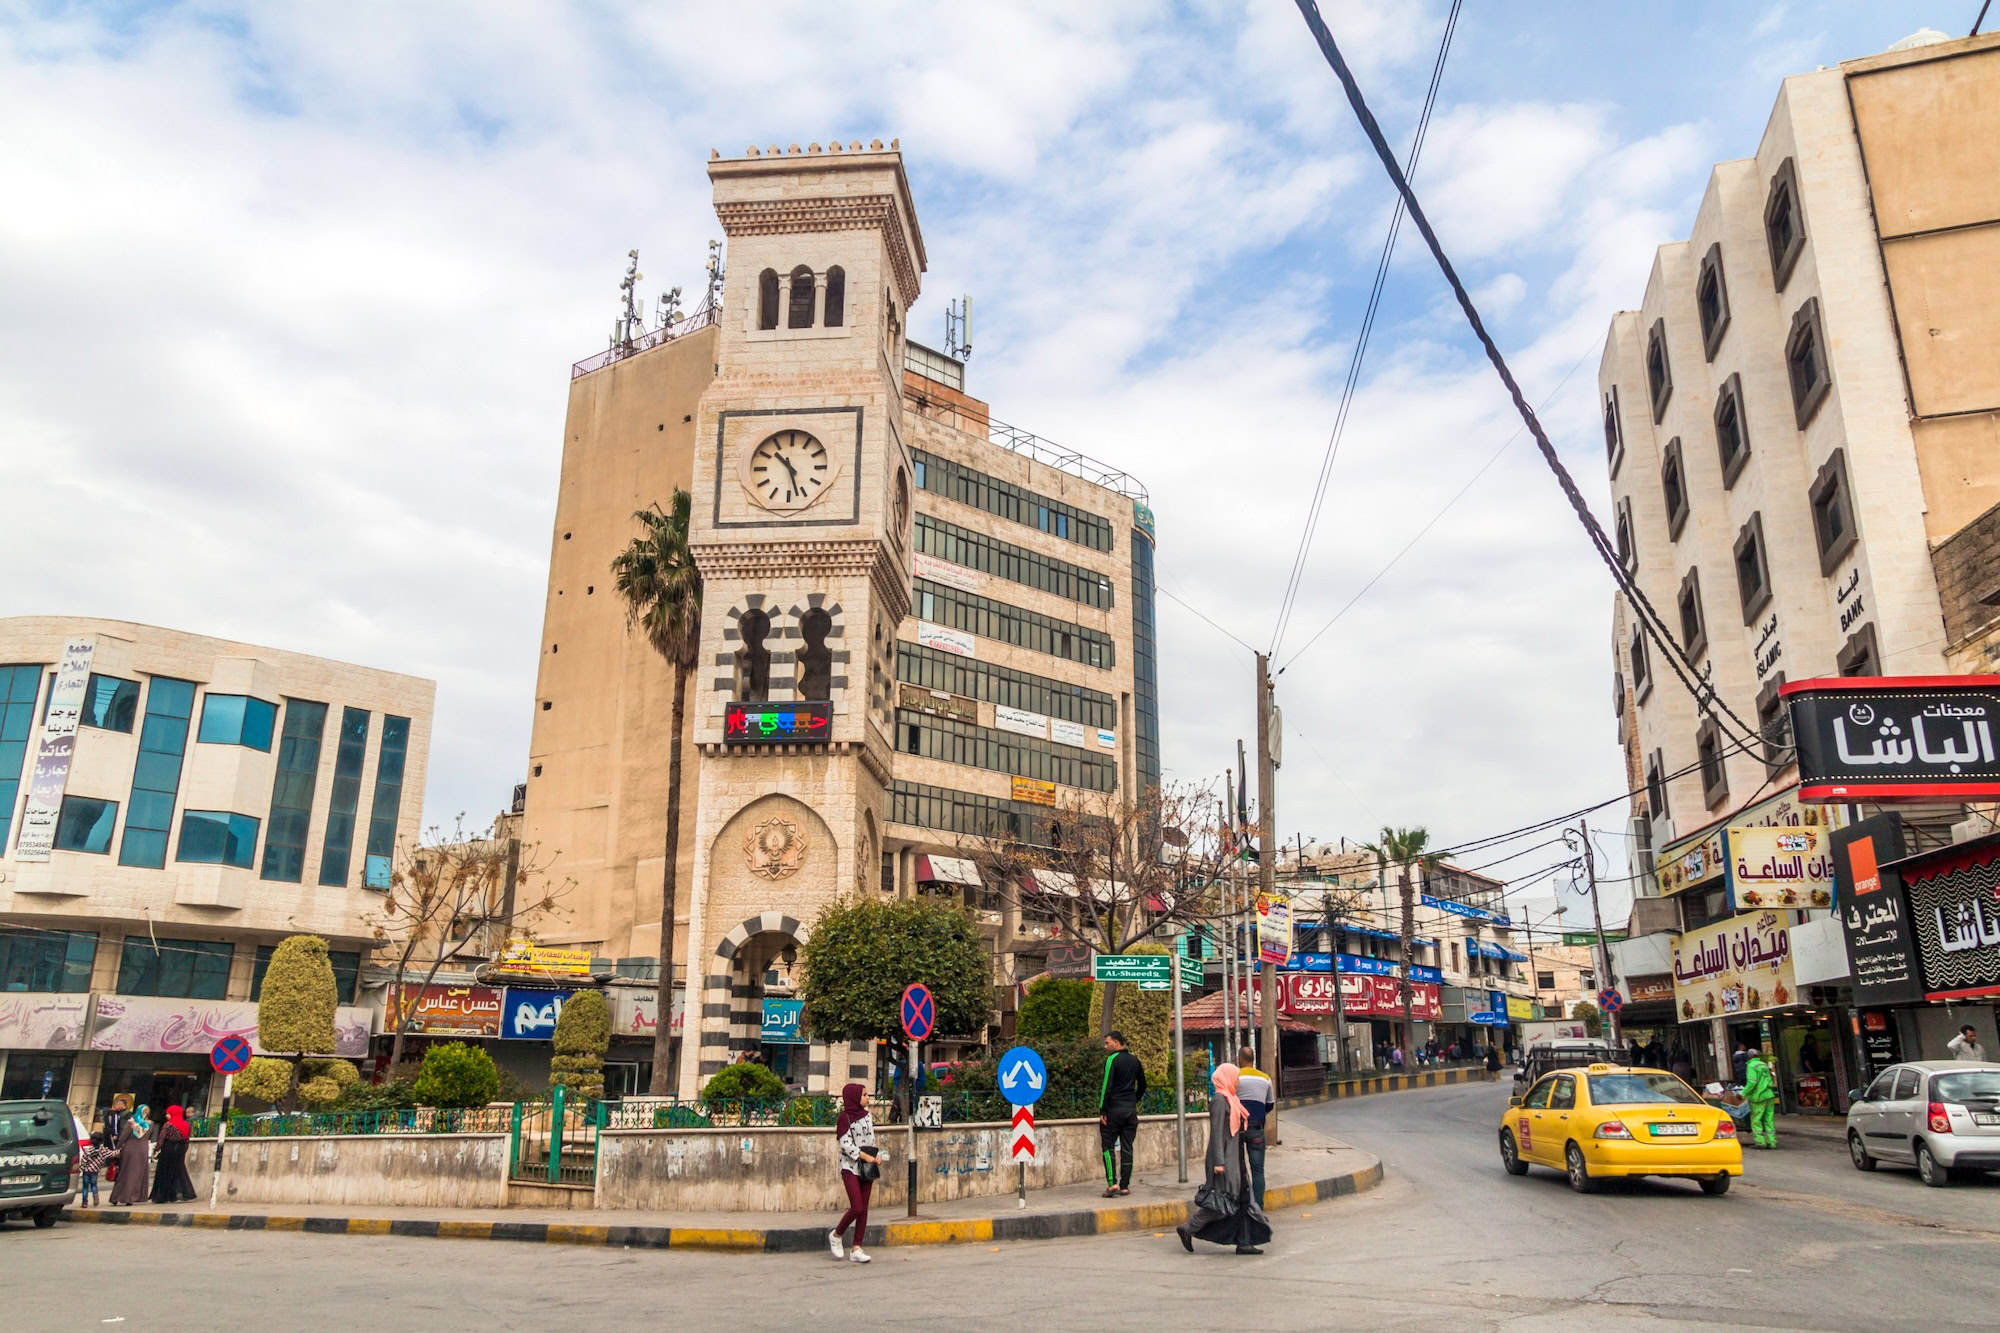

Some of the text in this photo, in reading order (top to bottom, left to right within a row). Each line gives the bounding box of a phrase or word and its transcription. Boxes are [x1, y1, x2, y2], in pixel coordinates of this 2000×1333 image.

[1756, 640, 1782, 681] ISLAMIC
[1839, 594, 1865, 633] BANK
[66, 644, 93, 658] مجمع
[1922, 703, 1986, 720] معجنات
[47, 723, 75, 736] لدينا
[39, 744, 72, 760] مكاتب
[1832, 714, 1996, 774] الباشا
[35, 764, 68, 778] تجارية
[1738, 855, 1805, 880] الساعة
[1854, 876, 1878, 892] orange
[1846, 897, 1900, 934] المحترف
[1674, 926, 1790, 982] ميدان الساعة
[447, 986, 471, 997] بن
[633, 995, 655, 1004] قطايف
[416, 994, 499, 1015] حسن عباس
[0, 1153, 68, 1168] YUNDAI
